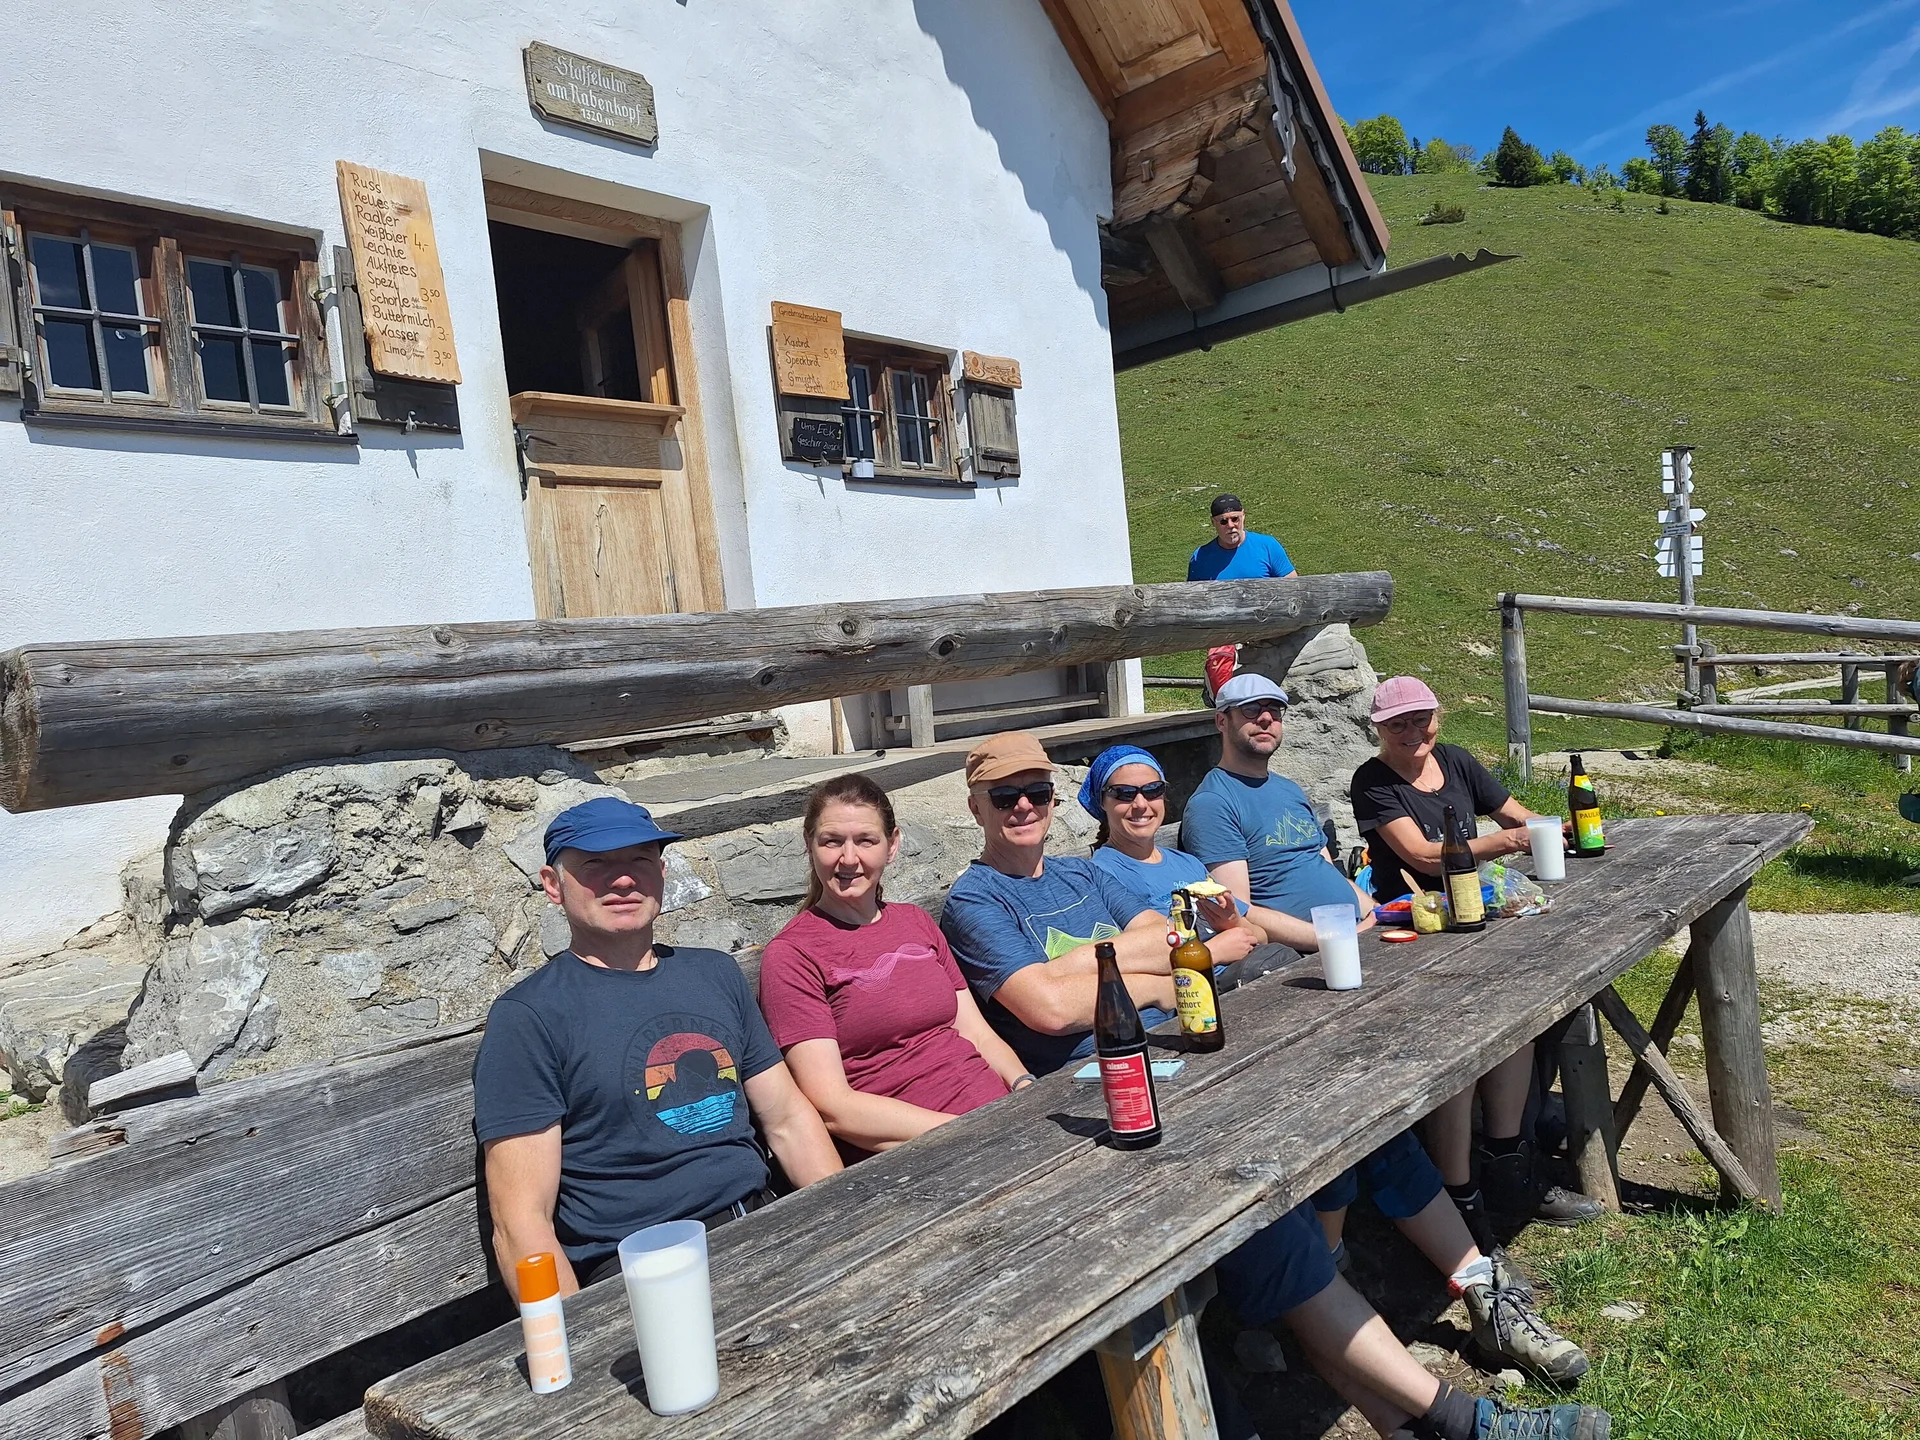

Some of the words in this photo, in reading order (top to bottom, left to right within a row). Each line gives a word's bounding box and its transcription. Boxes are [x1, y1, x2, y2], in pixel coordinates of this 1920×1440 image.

[555, 55, 628, 95] Staffelalm
[547, 82, 568, 100] am
[568, 82, 642, 127] Rabenkopf
[581, 108, 603, 123] 1320
[605, 117, 615, 127] m
[350, 172, 382, 194] Russ
[352, 189, 390, 210] Helles
[355, 205, 400, 227] Radler
[360, 222, 408, 244] Weißbier
[361, 237, 407, 260] Leichte
[366, 256, 418, 278] Alkfreies
[367, 271, 399, 290] Spezi
[370, 289, 411, 308] Schorle
[372, 305, 436, 329] Buttermilch
[375, 322, 420, 342] Wasser
[382, 341, 407, 357] Limo
[1176, 999, 1202, 1010] schorr
